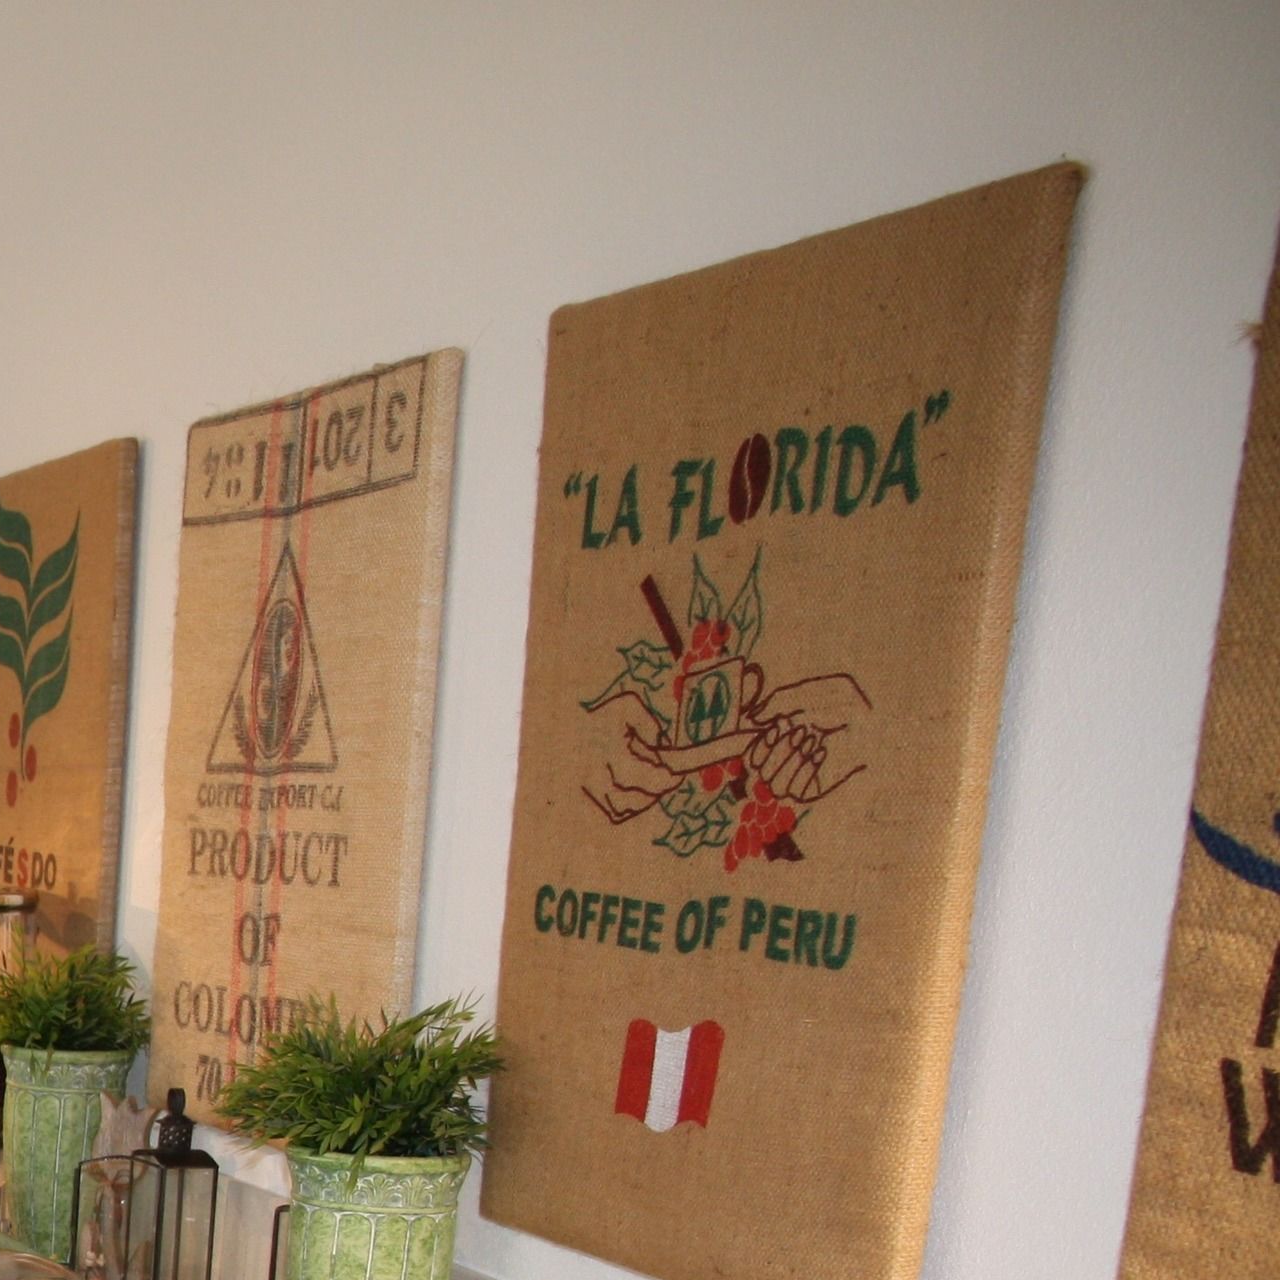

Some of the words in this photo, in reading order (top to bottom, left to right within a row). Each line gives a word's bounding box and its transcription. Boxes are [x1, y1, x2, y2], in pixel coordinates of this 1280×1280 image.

[197, 781, 254, 811] COFFEE
[187, 826, 350, 888] PRODUCT
[237, 910, 282, 968] OF
[533, 883, 667, 953] COFFEE
[674, 895, 732, 955] OF
[738, 896, 858, 971] PERU
[194, 1053, 224, 1105] 70
